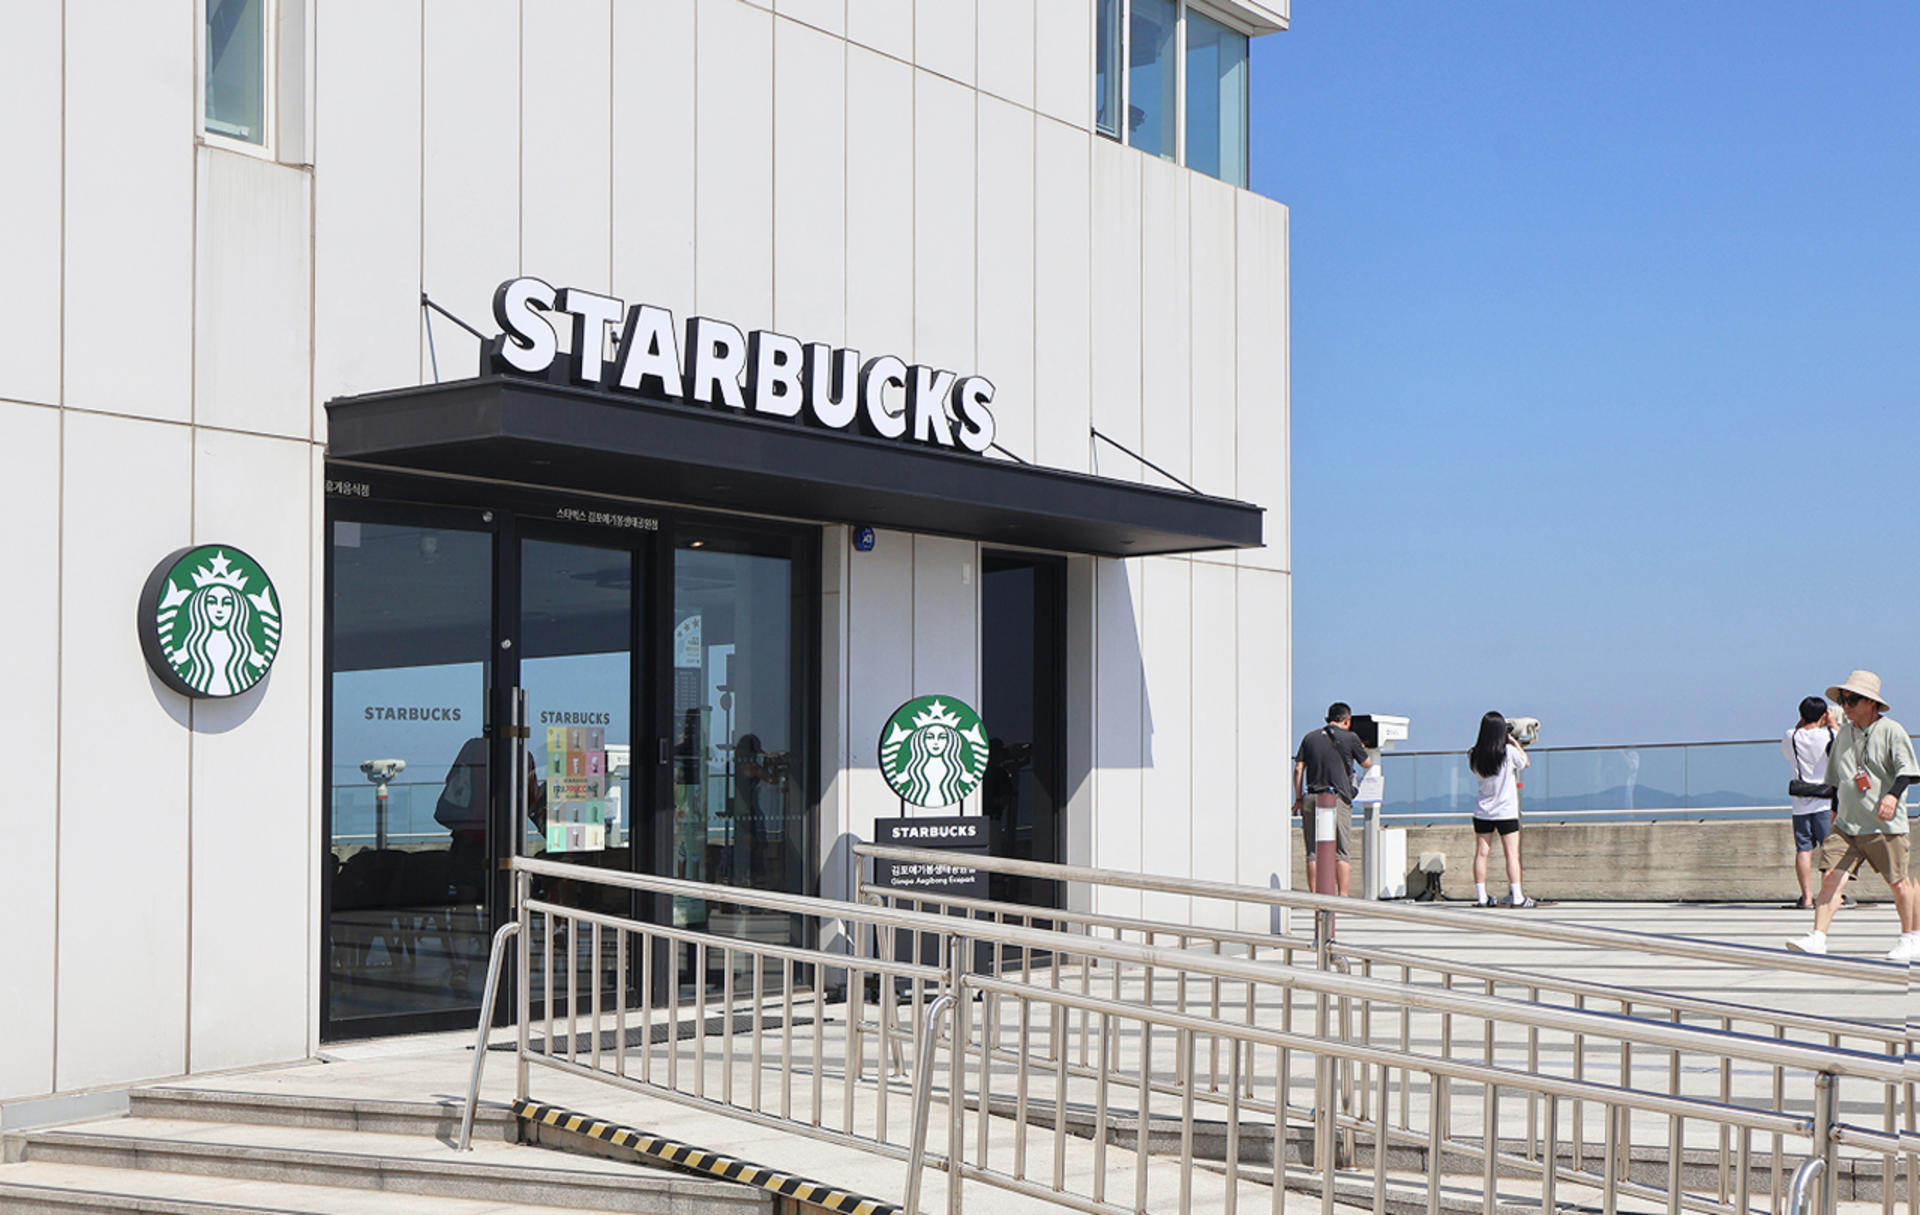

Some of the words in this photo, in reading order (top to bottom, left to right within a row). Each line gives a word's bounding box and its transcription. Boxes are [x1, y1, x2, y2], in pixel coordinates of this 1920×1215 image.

[496, 277, 996, 453] STARBUCKS
[556, 508, 587, 521] 스타벅스
[364, 706, 462, 721] STARBUCKS
[540, 711, 610, 725] STARBUCKS
[891, 826, 977, 838] STARBUCKS
[890, 878, 914, 886] Gimpo
